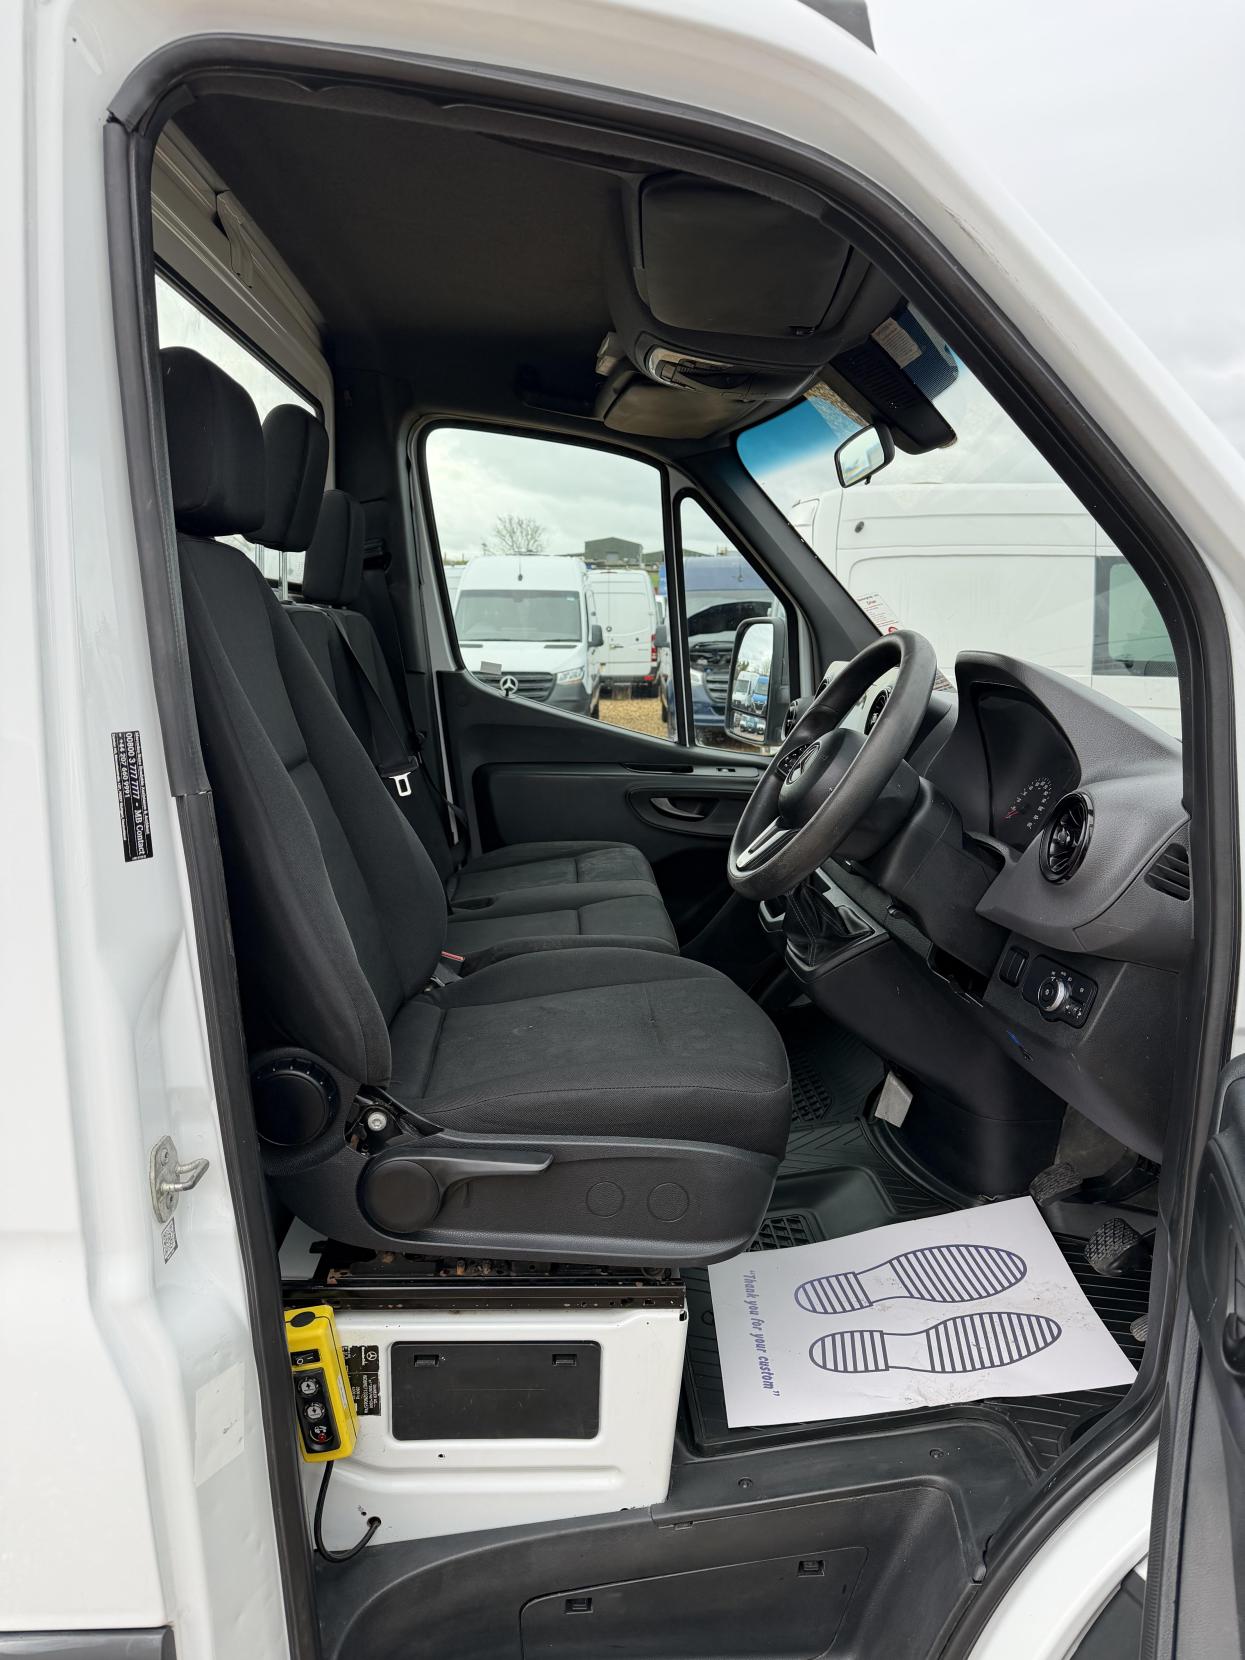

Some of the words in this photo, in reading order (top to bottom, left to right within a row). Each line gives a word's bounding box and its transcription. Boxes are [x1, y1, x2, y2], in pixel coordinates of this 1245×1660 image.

[126, 732, 136, 756] 00800
[130, 764, 138, 779] 777
[131, 780, 140, 799] 7777
[134, 808, 143, 823] MB
[136, 824, 147, 855] Contact
[744, 1300, 760, 1316] you
[751, 1318, 765, 1331] for
[750, 1333, 767, 1354] your
